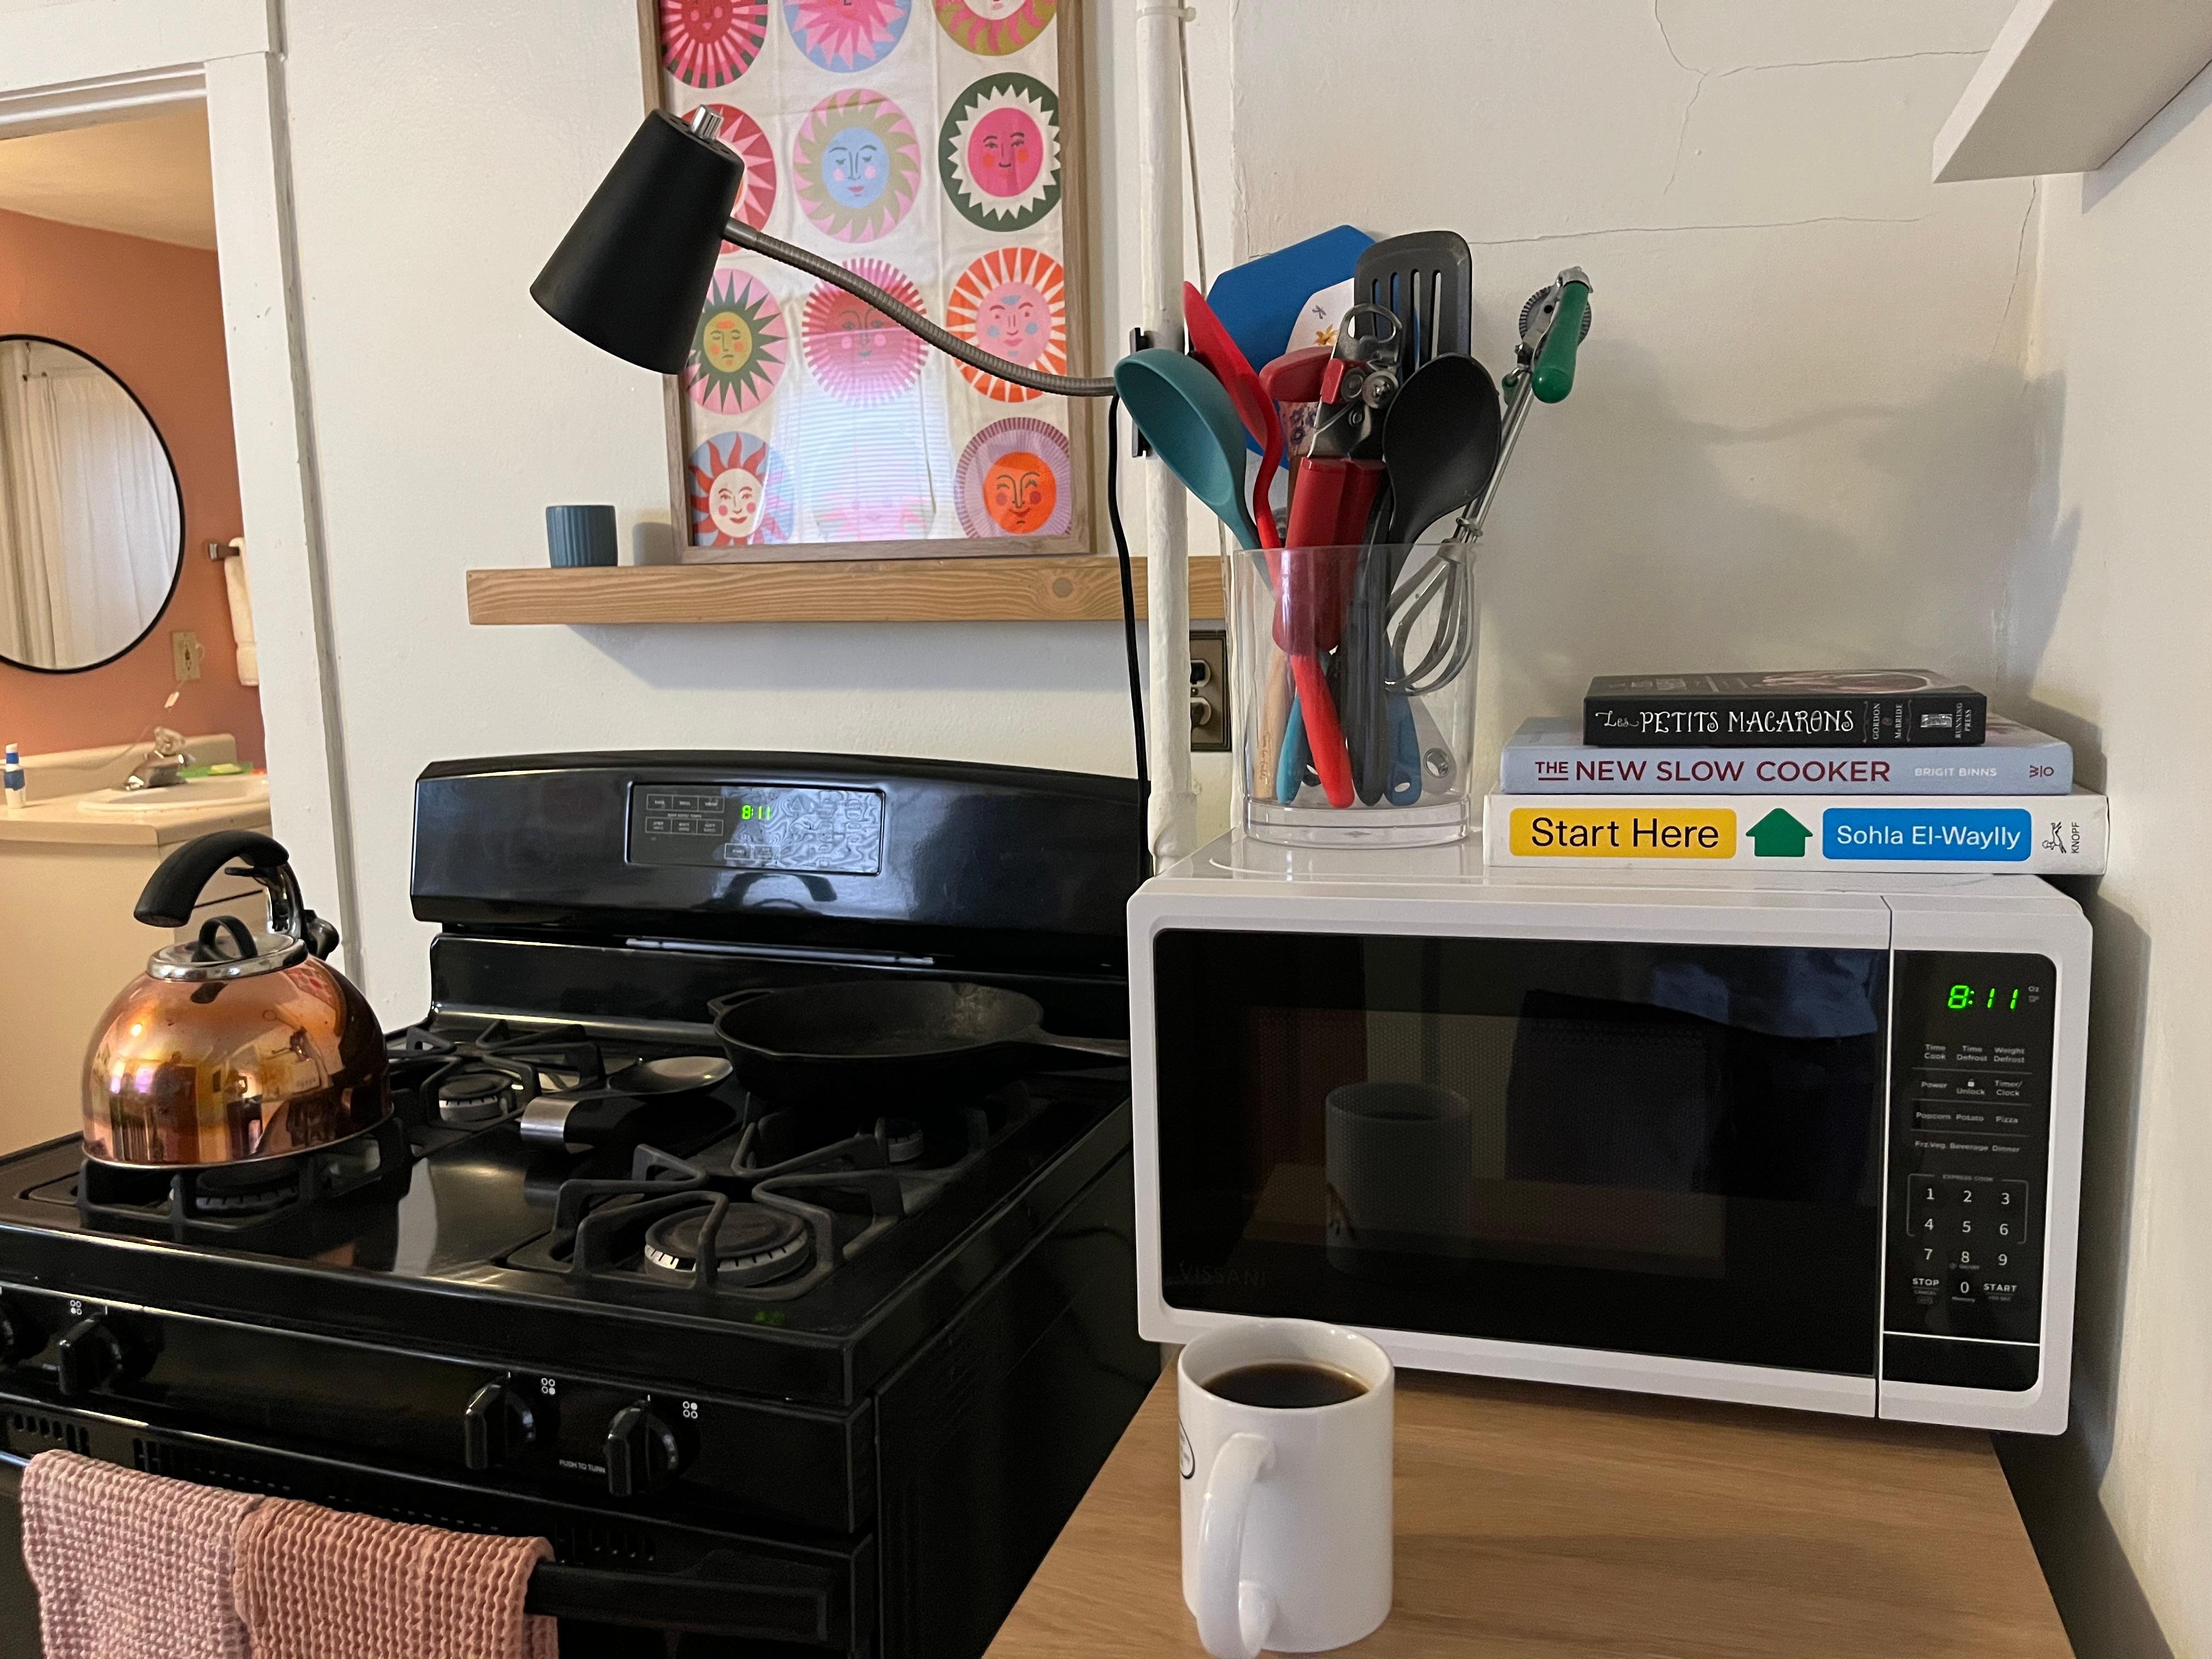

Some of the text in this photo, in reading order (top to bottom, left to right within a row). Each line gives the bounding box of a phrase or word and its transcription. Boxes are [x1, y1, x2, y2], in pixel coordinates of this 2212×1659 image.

[1595, 710, 1854, 734] Les PETITS MACARONS
[1872, 703, 1881, 740] GORDON
[1894, 703, 1903, 739] McBRIDE
[1955, 703, 1963, 738] RUNNING
[1535, 760, 1891, 782] THE NEW SLOW COOKER
[1915, 768, 1997, 777] BRIGIT BINNS
[742, 804, 771, 820] 8:11
[1532, 817, 1719, 848] Start Here
[1837, 825, 2021, 850] Sohla El-Waylly
[2071, 821, 2080, 854] KNOPF
[1948, 985, 2019, 1010] 8:11
[1994, 1047, 2025, 1055] Weight
[1956, 1053, 1988, 1062] Defrost
[1994, 1056, 2025, 1064] Defrost
[1916, 1111, 1951, 1120] Popcorn
[1956, 1114, 1984, 1122] Potato
[1995, 1115, 2019, 1124] Pizza
[1949, 1142, 1989, 1152] Beverage
[1992, 1144, 2021, 1153] Dinner
[1926, 1188, 1935, 1200] 1
[1963, 1190, 1972, 1203] 2
[2001, 1192, 2010, 1205] 3
[1924, 1218, 1934, 1231] 4
[1962, 1220, 1971, 1233] 5
[1999, 1223, 2009, 1235] 6
[1923, 1248, 1933, 1260] 7
[1960, 1251, 1970, 1263] 8
[1997, 1254, 2007, 1266] 9
[1912, 1277, 1939, 1286] STOP
[1960, 1281, 1970, 1294] 0
[1983, 1283, 2018, 1293] START
